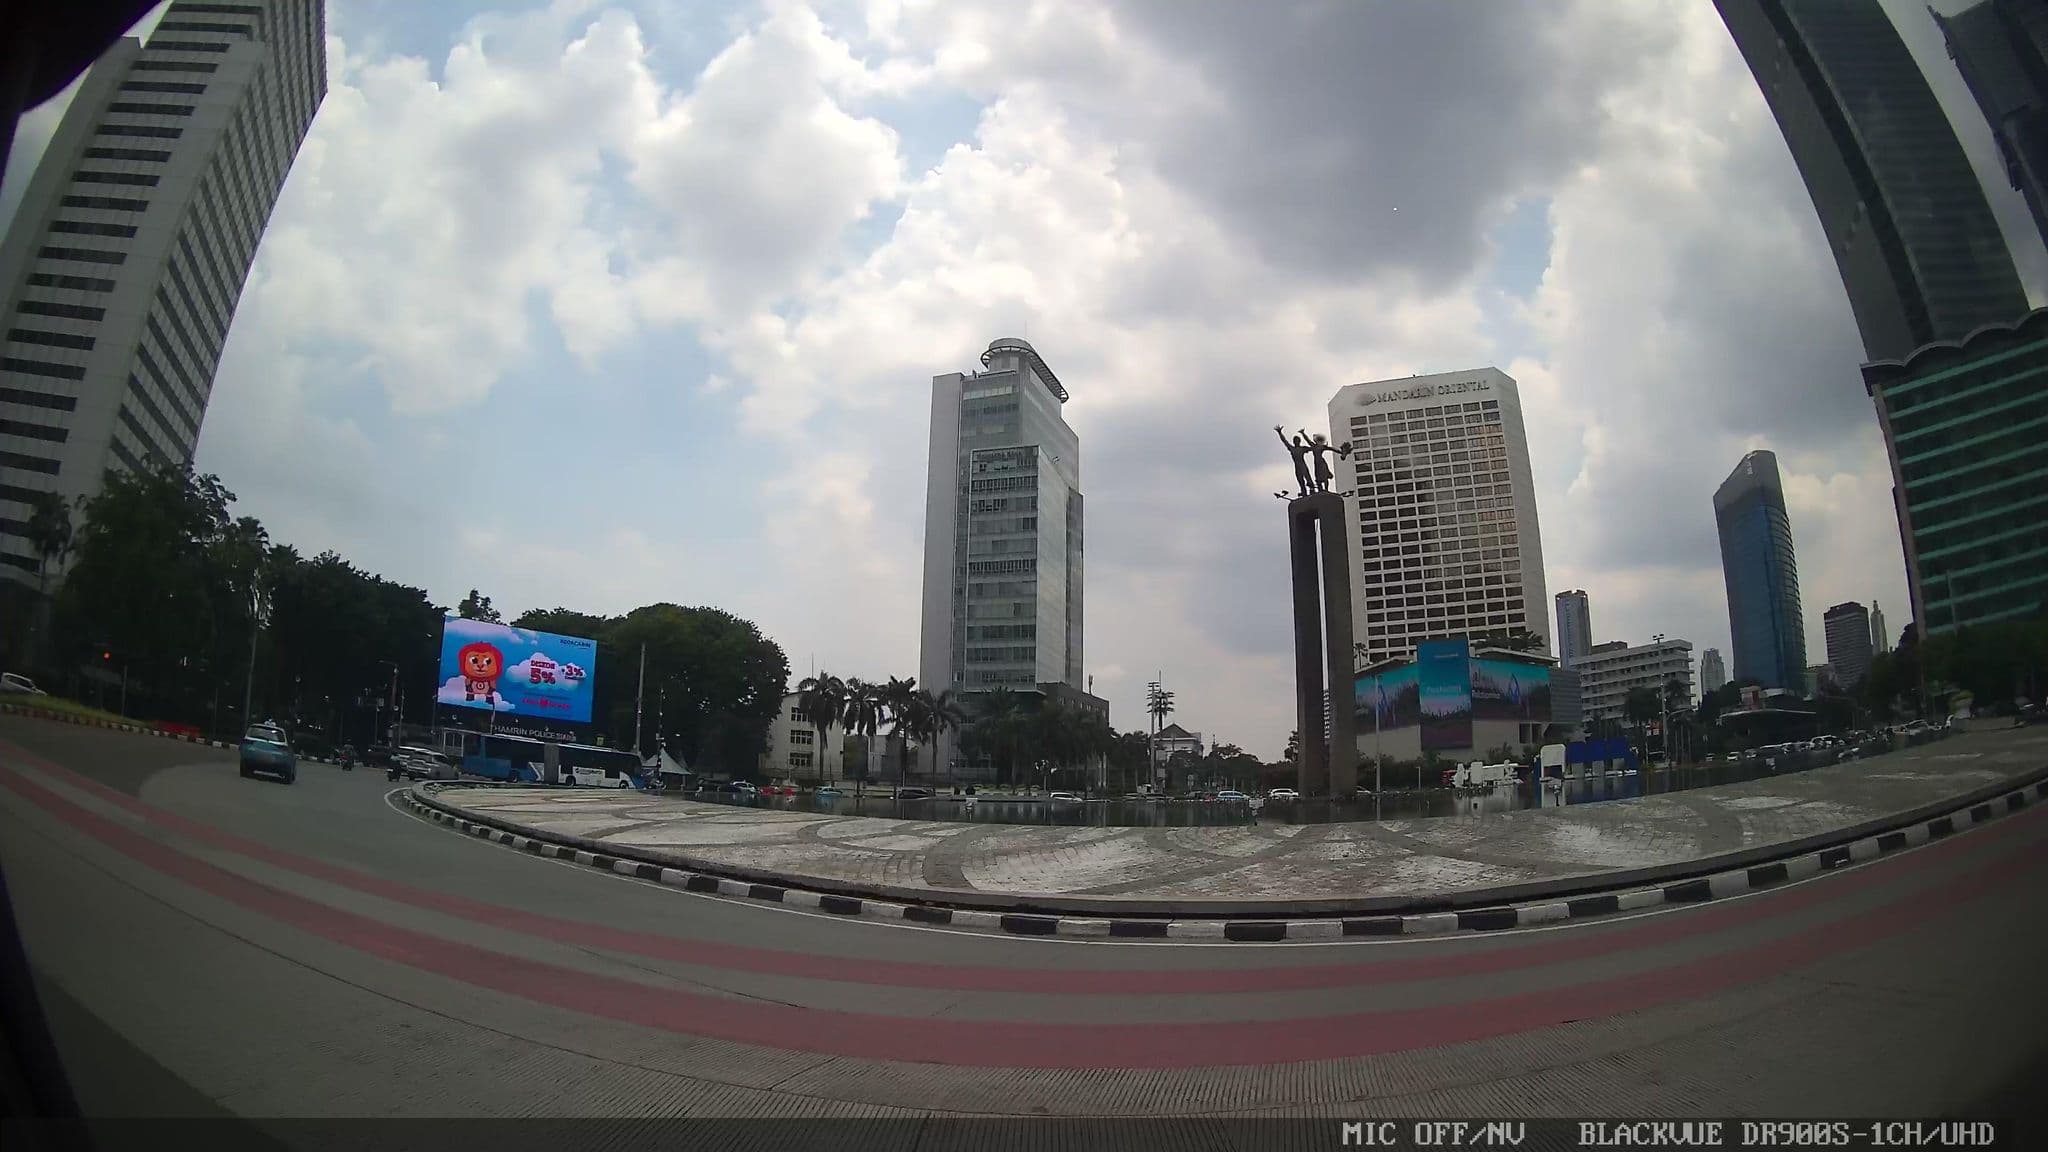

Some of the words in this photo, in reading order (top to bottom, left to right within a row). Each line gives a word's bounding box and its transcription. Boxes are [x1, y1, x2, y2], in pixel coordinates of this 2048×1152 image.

[1376, 385, 1435, 402] MANDARIN
[1437, 380, 1490, 395] ORIENTAL
[530, 668, 556, 685] 5%
[529, 729, 556, 739] POLICE
